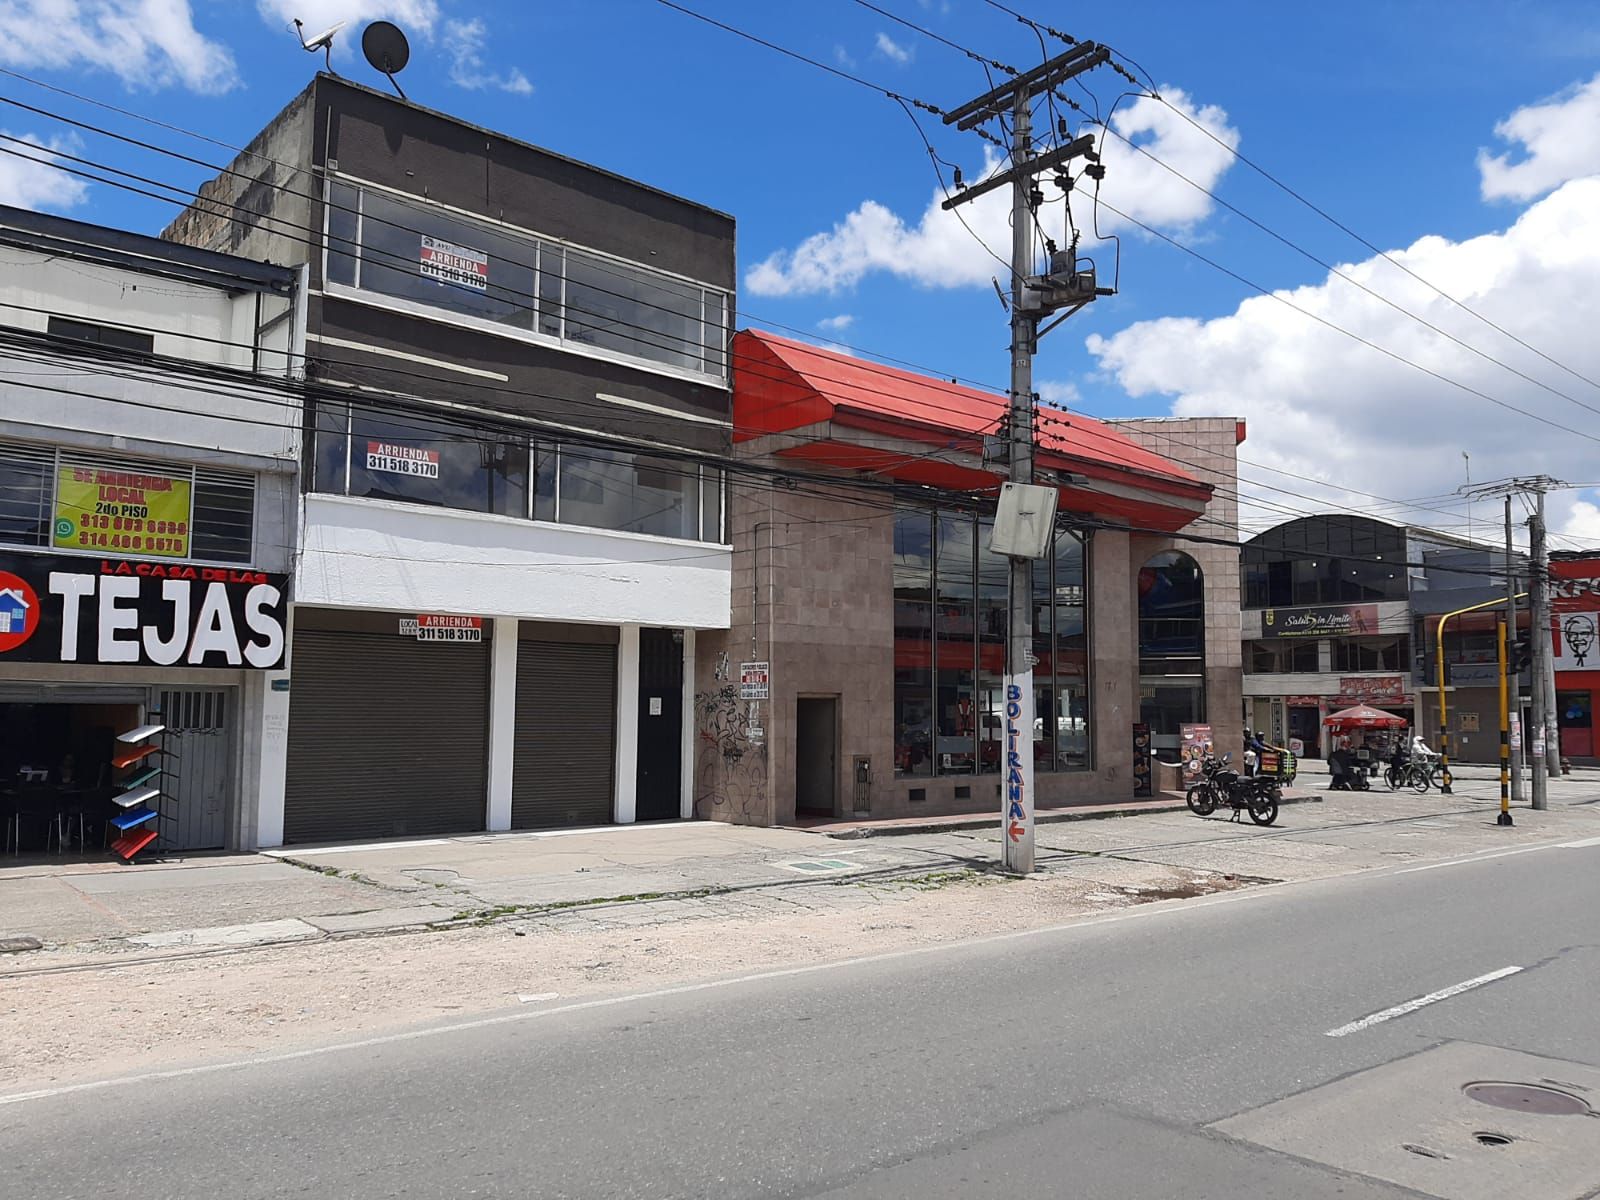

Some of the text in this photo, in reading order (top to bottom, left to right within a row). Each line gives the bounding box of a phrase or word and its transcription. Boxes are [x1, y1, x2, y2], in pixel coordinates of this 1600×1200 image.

[430, 251, 479, 272] ARRIENDA
[377, 443, 430, 461] ARRIENDA
[369, 455, 437, 476] 311 518 3170
[73, 467, 173, 491] SE ARRIENDA
[98, 486, 147, 505] LOCAL
[95, 502, 148, 518] 2do PISO
[80, 513, 109, 529] 313
[79, 531, 108, 547] 314
[101, 560, 268, 585] LA CASA DE LAS
[48, 572, 285, 669] TEJAS
[425, 616, 473, 627] ARRIENDA
[418, 628, 436, 639] 311
[437, 628, 455, 640] 518
[457, 629, 480, 641] 3170
[1007, 684, 1026, 820] BOLIRANA
